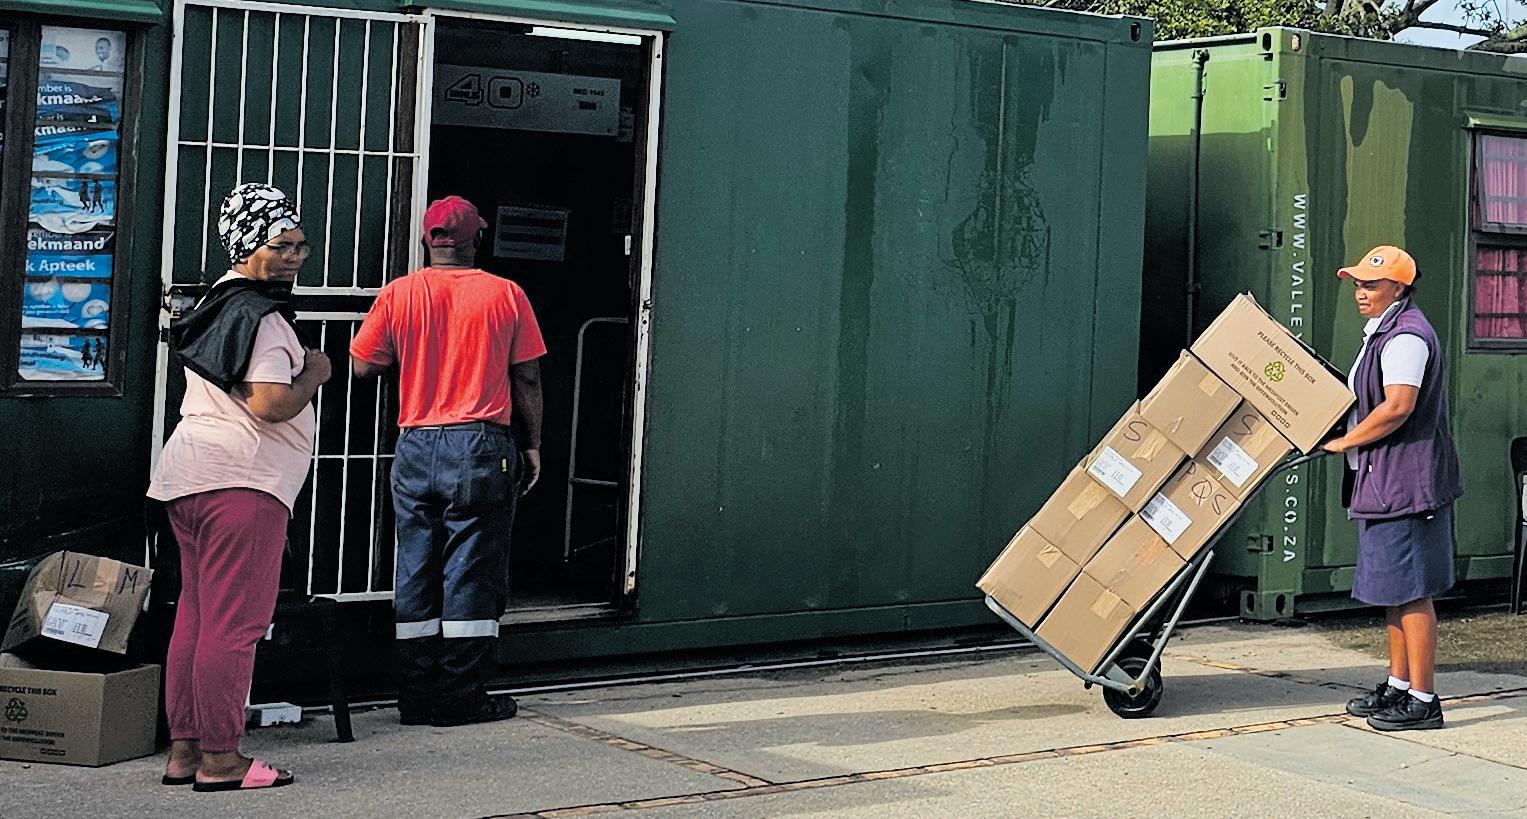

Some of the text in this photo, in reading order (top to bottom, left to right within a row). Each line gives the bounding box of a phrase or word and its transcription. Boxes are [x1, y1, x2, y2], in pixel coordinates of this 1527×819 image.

[27, 236, 105, 250] ekmaand
[39, 259, 95, 273] Apteek
[1257, 331, 1316, 384] PLEASE RECYCLE THIS BOX
[1123, 420, 1149, 442] S
[43, 688, 57, 696] BOX
